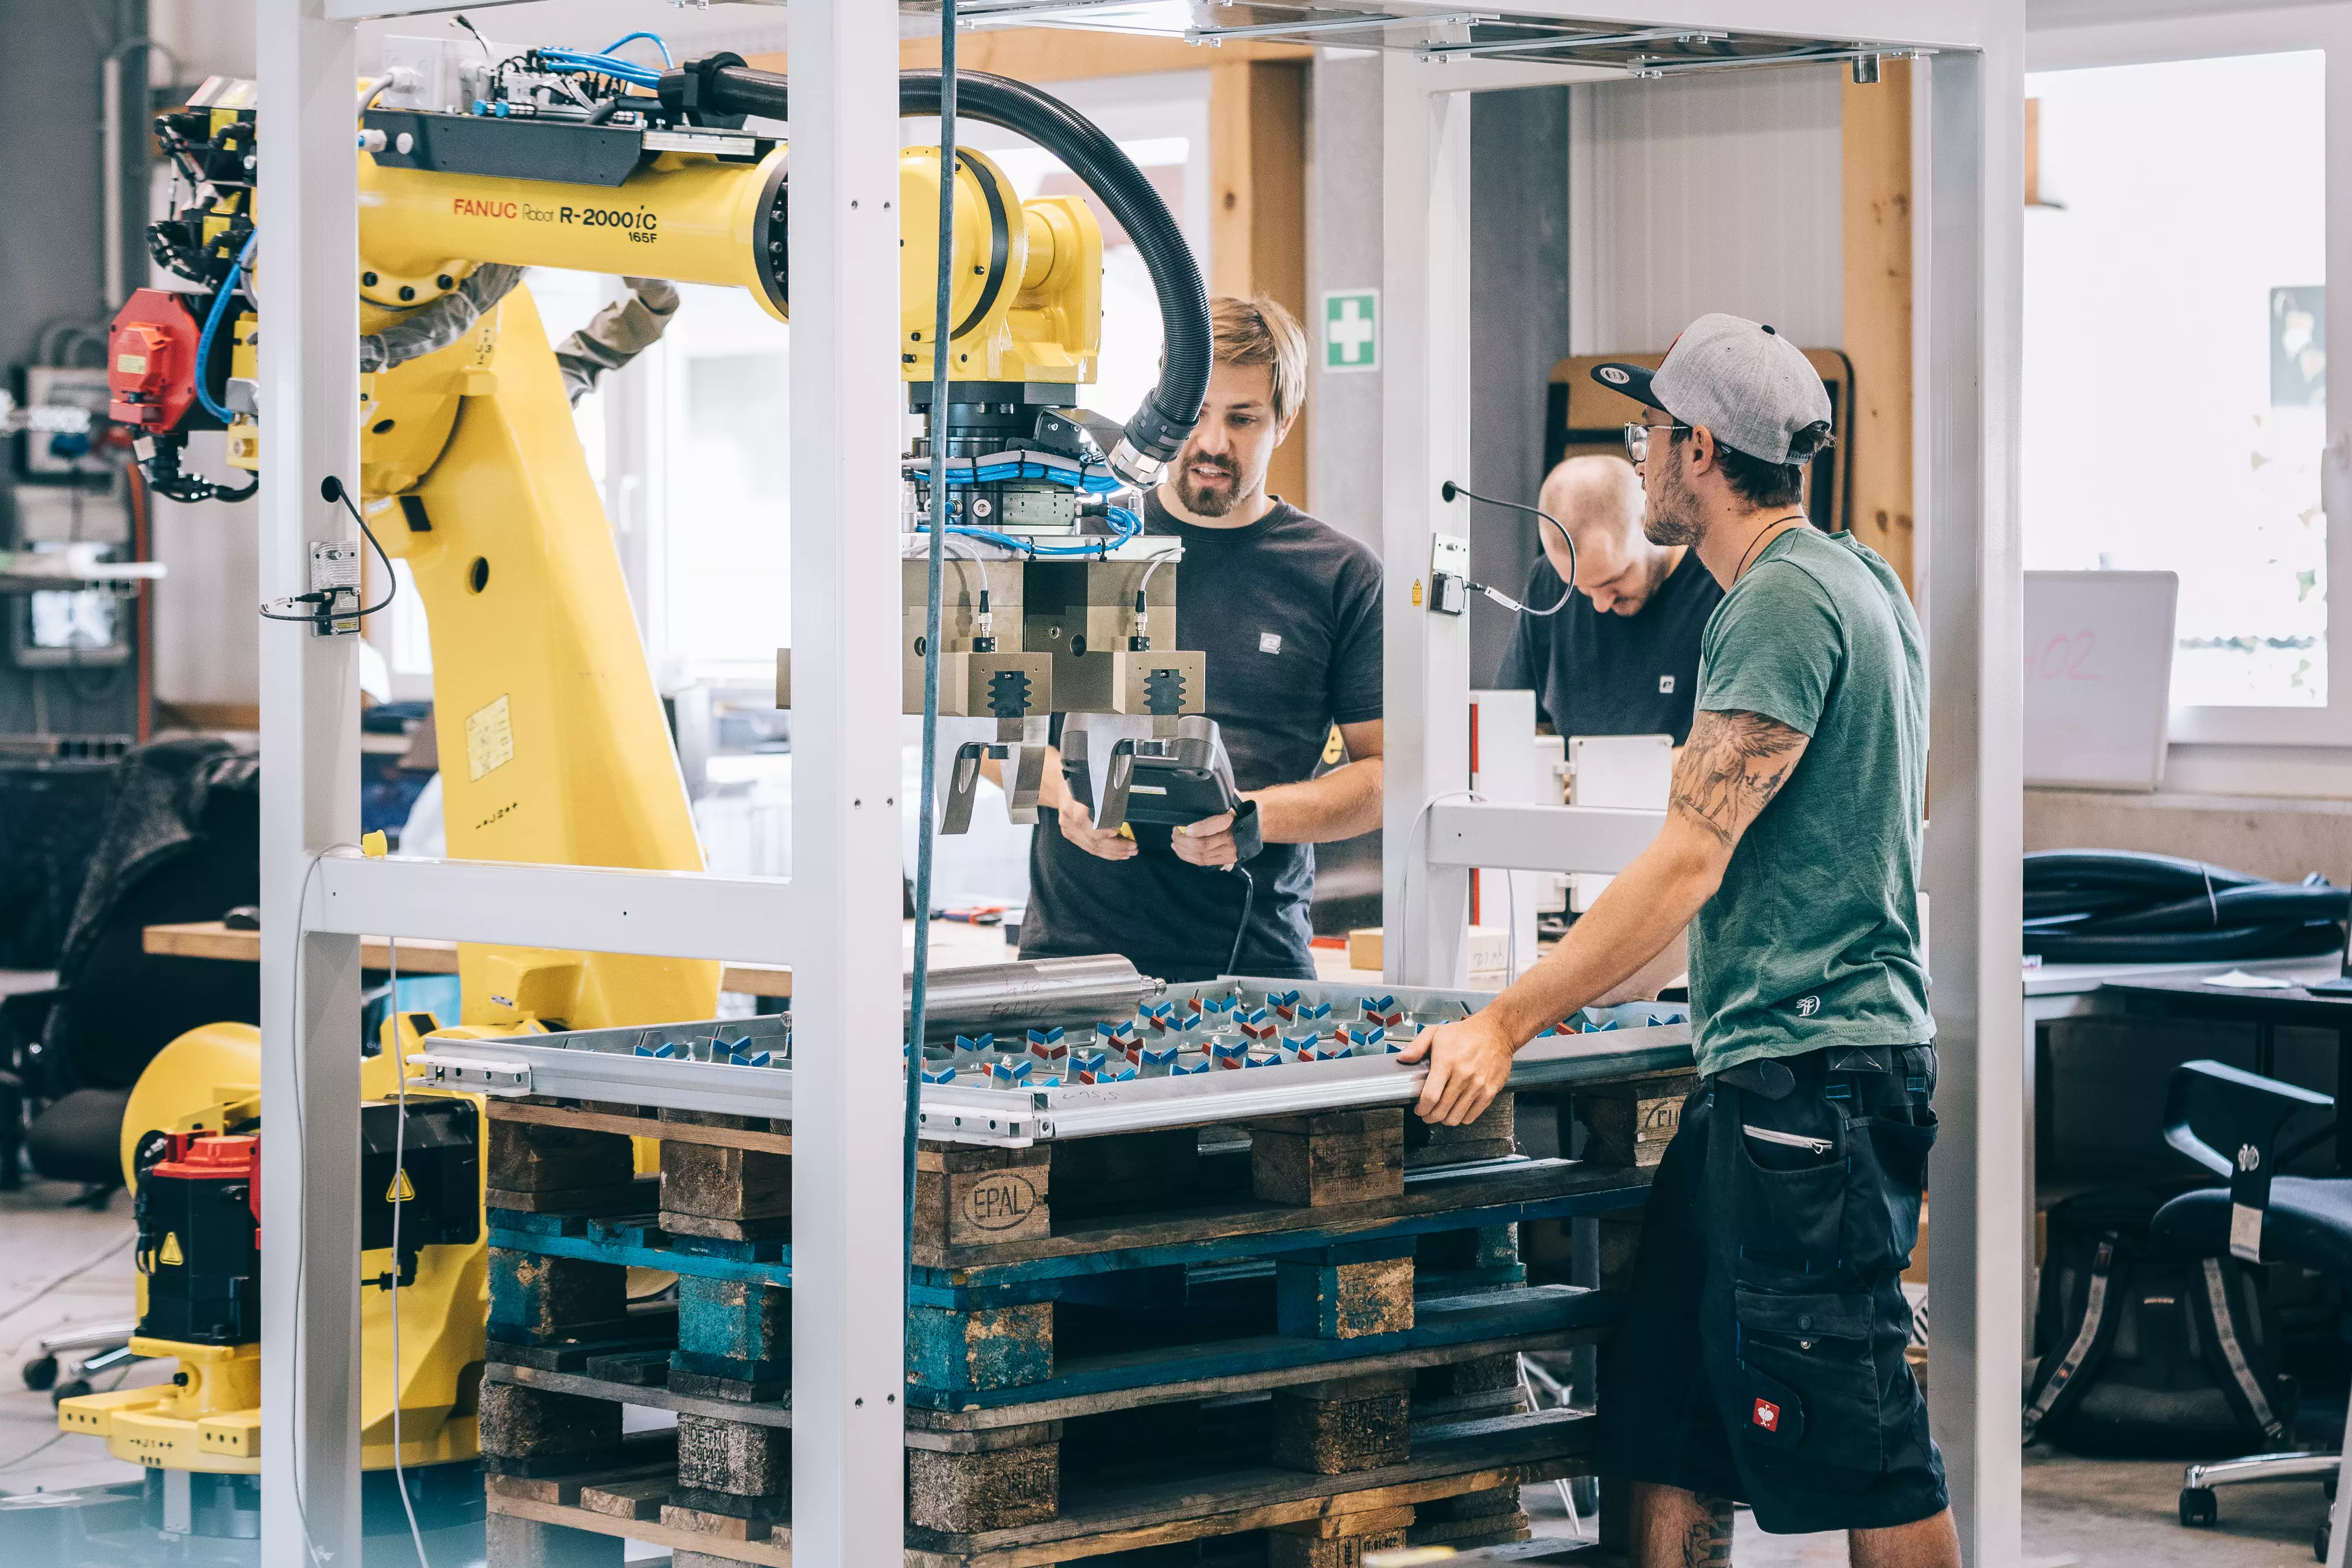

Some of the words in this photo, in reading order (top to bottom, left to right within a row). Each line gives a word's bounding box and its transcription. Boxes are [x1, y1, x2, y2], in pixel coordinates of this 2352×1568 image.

[454, 199, 517, 219] FANUC
[523, 203, 554, 222] Robot
[629, 231, 657, 243] 165F
[974, 1185, 1026, 1218] EPAL
